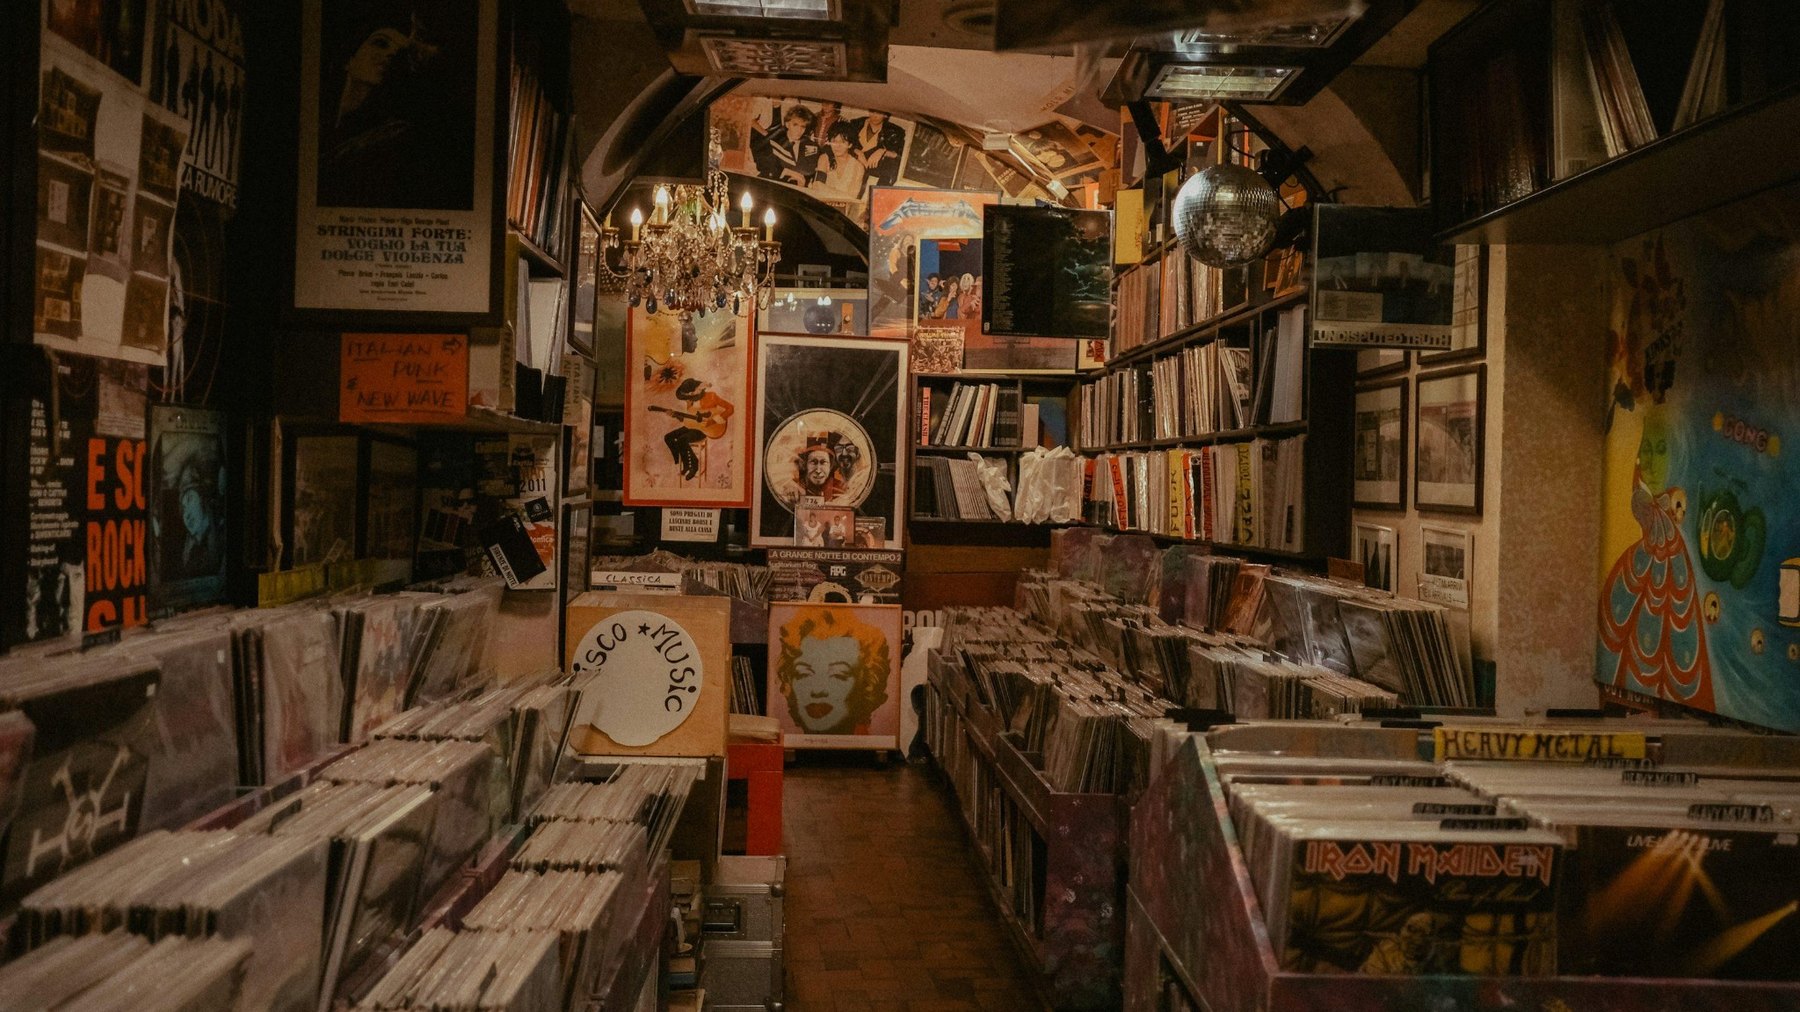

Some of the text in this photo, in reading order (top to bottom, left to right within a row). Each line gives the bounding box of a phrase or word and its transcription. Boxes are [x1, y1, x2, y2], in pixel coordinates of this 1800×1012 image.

[317, 224, 472, 240] STRINGIMI FORTE:
[347, 238, 467, 252] VOGLIO LA TUA
[382, 251, 465, 264] VIOLENZA
[1318, 330, 1447, 346] UNDISPUTED TRUTH
[347, 341, 432, 356] ITALIAN
[392, 360, 448, 377] PUNK
[573, 362, 581, 404] ITALIAN
[357, 389, 457, 409] NEW WAVE
[520, 478, 546, 493] 2011
[86, 519, 146, 593] ROCK
[780, 551, 814, 559] GRANDE
[815, 552, 841, 560] NOTTE
[842, 552, 850, 560] DI
[851, 553, 896, 561] CONTEMPO
[1443, 731, 1623, 758] HEAVY METAL
[1305, 841, 1554, 888] IRON MAIDEN
